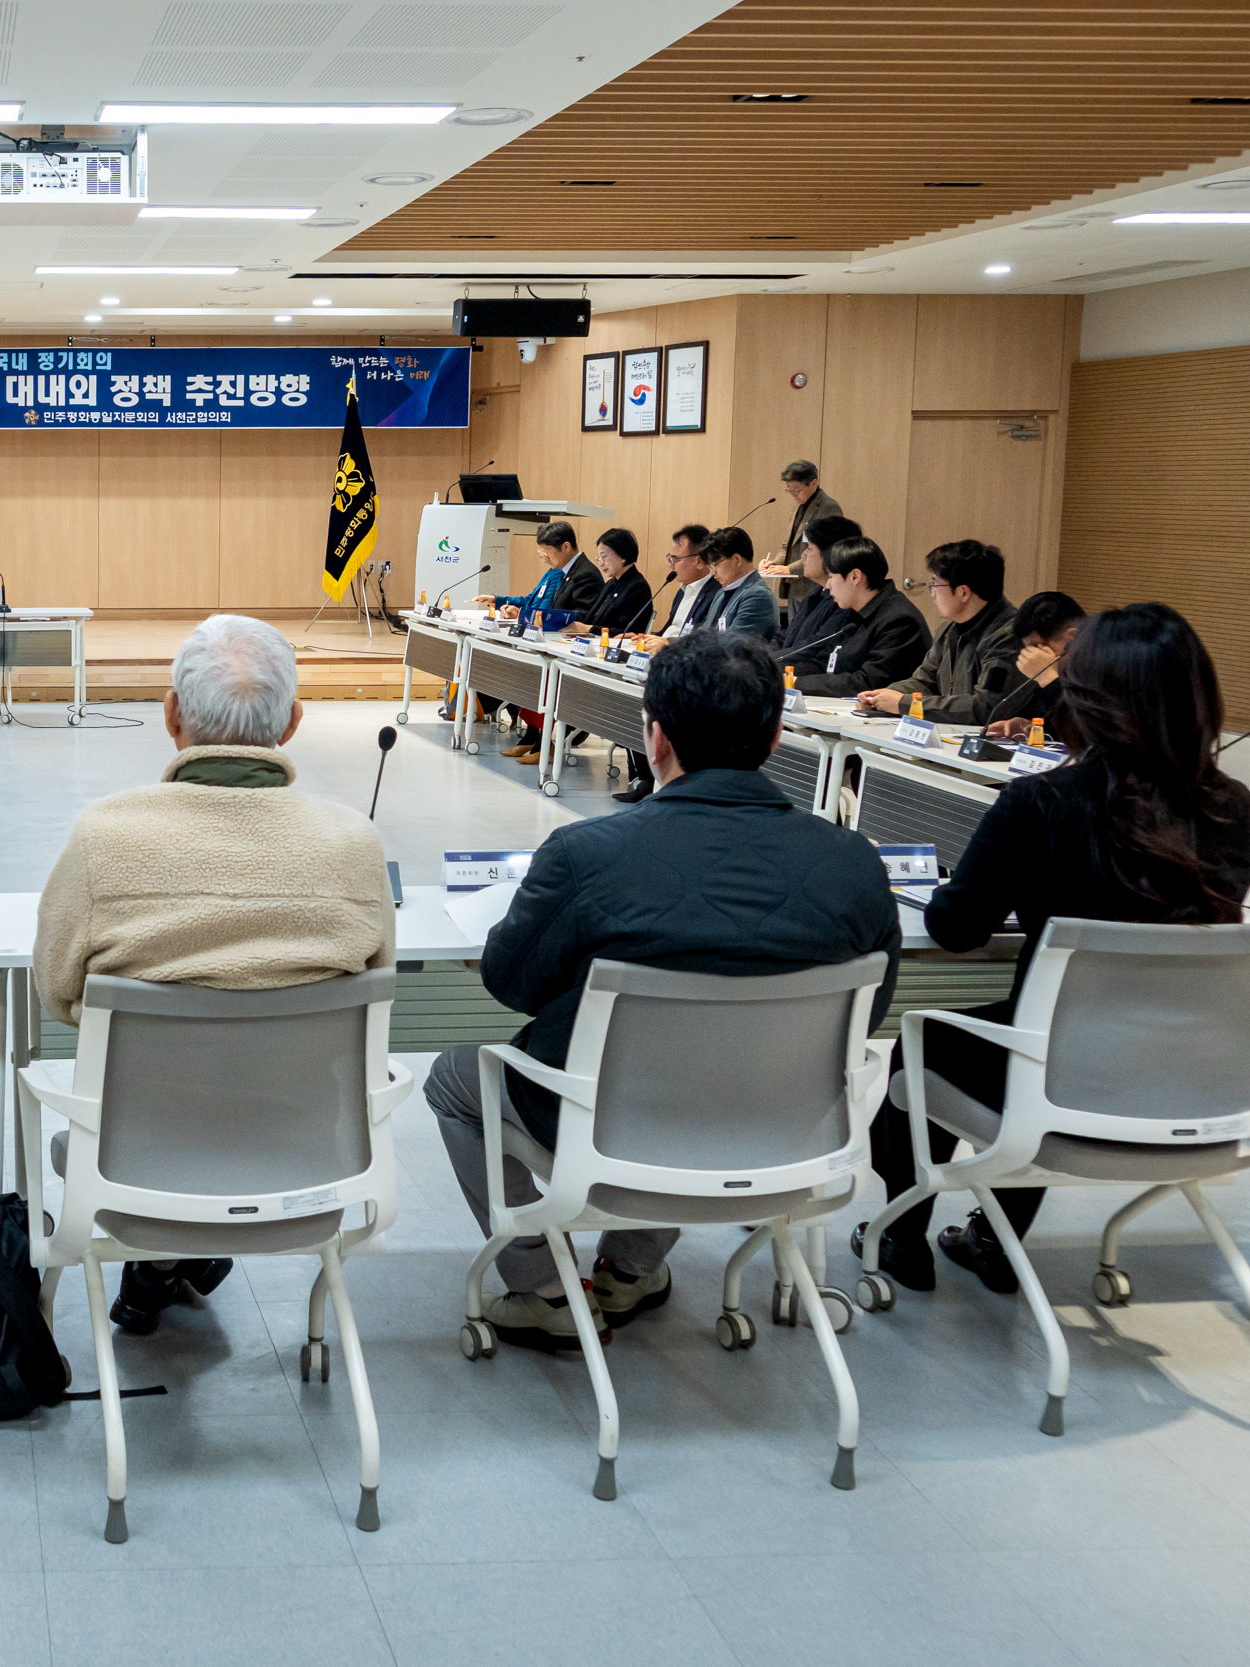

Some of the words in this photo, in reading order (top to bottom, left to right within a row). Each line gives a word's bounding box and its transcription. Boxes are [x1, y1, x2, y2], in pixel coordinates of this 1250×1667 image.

[37, 352, 112, 371] 정기회의
[358, 355, 389, 367] 만드는
[394, 355, 420, 368] 평화
[366, 370, 377, 380] 더
[5, 374, 97, 407] 대내외
[109, 374, 172, 408] 정책
[185, 374, 310, 407] 추진방향
[43, 411, 159, 424] 민주평화통일자문회의
[165, 411, 230, 424] 서천군협의회
[334, 491, 374, 558] 민주평화통일
